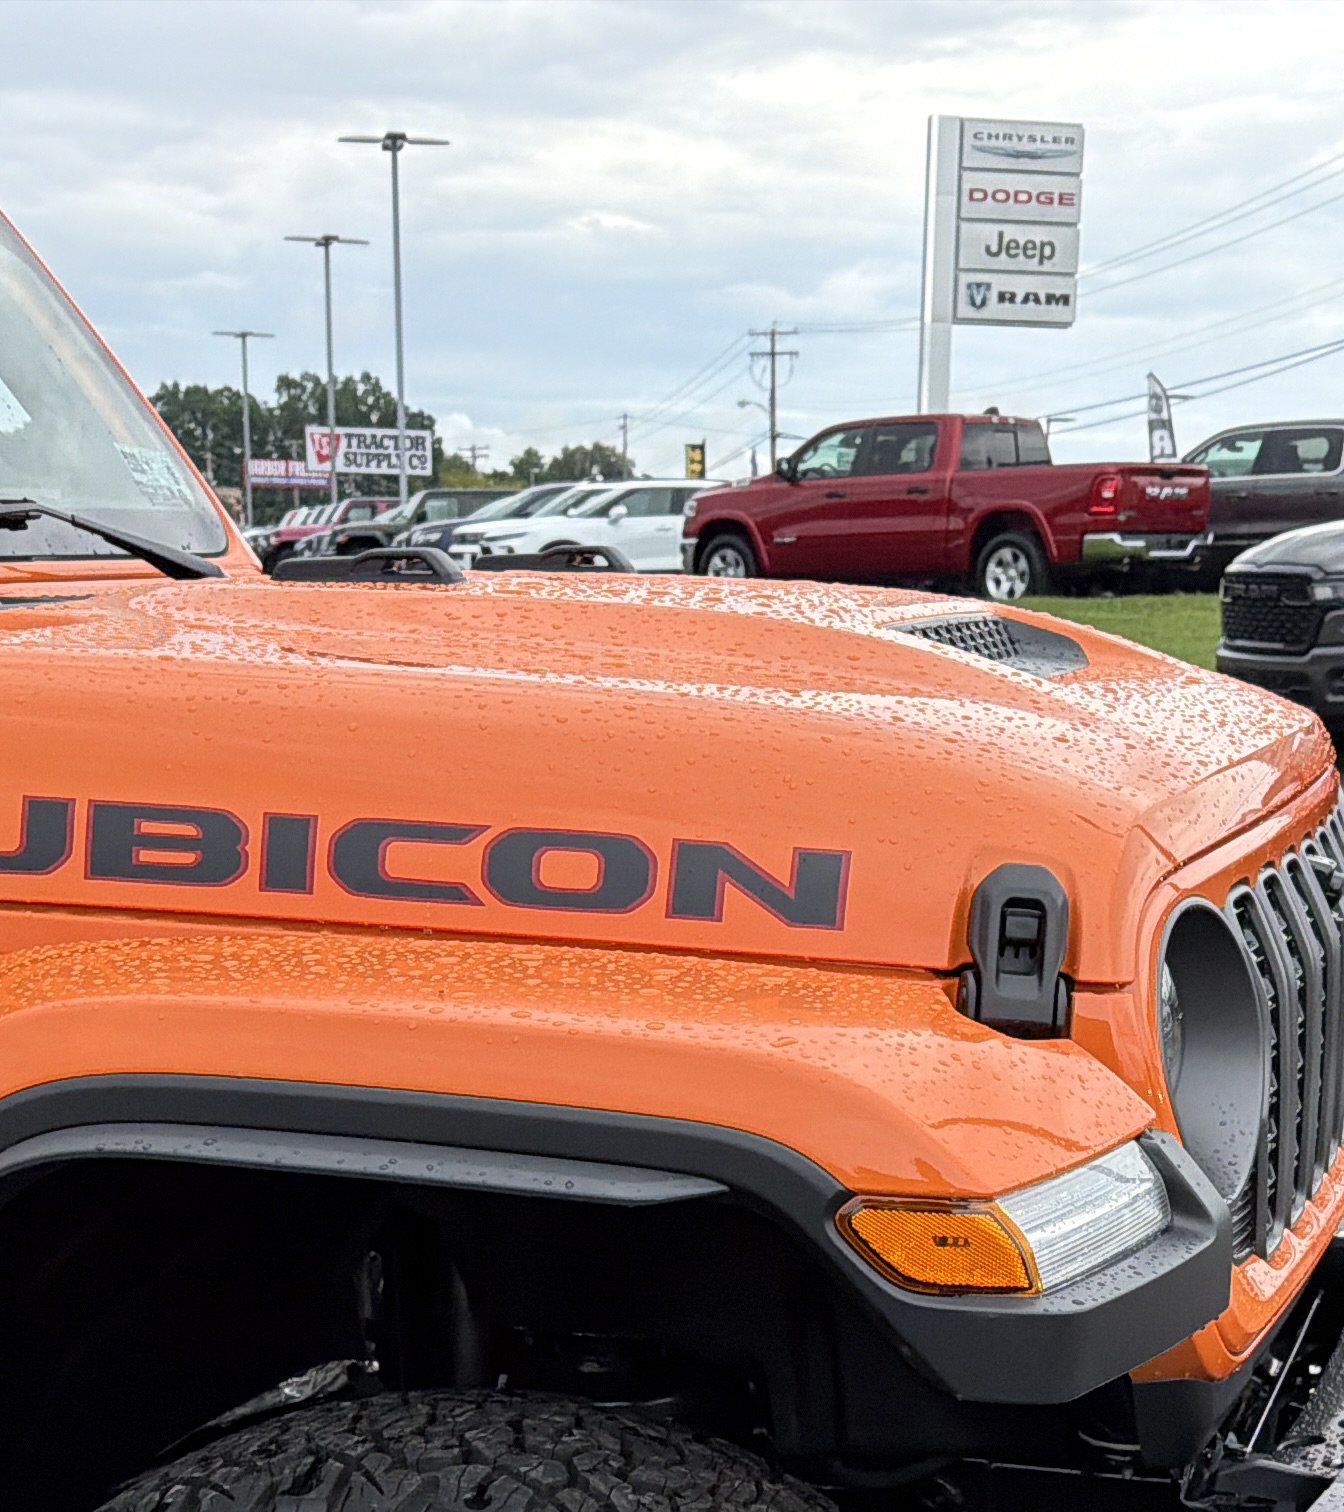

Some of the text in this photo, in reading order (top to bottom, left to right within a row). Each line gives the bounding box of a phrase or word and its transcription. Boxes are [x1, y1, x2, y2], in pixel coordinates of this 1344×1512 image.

[972, 131, 1076, 146] CHRYSLER
[968, 187, 1076, 207] DODGE
[985, 230, 1056, 266] Jeep
[997, 289, 1072, 307] RAM
[344, 432, 427, 452] TRACTOR
